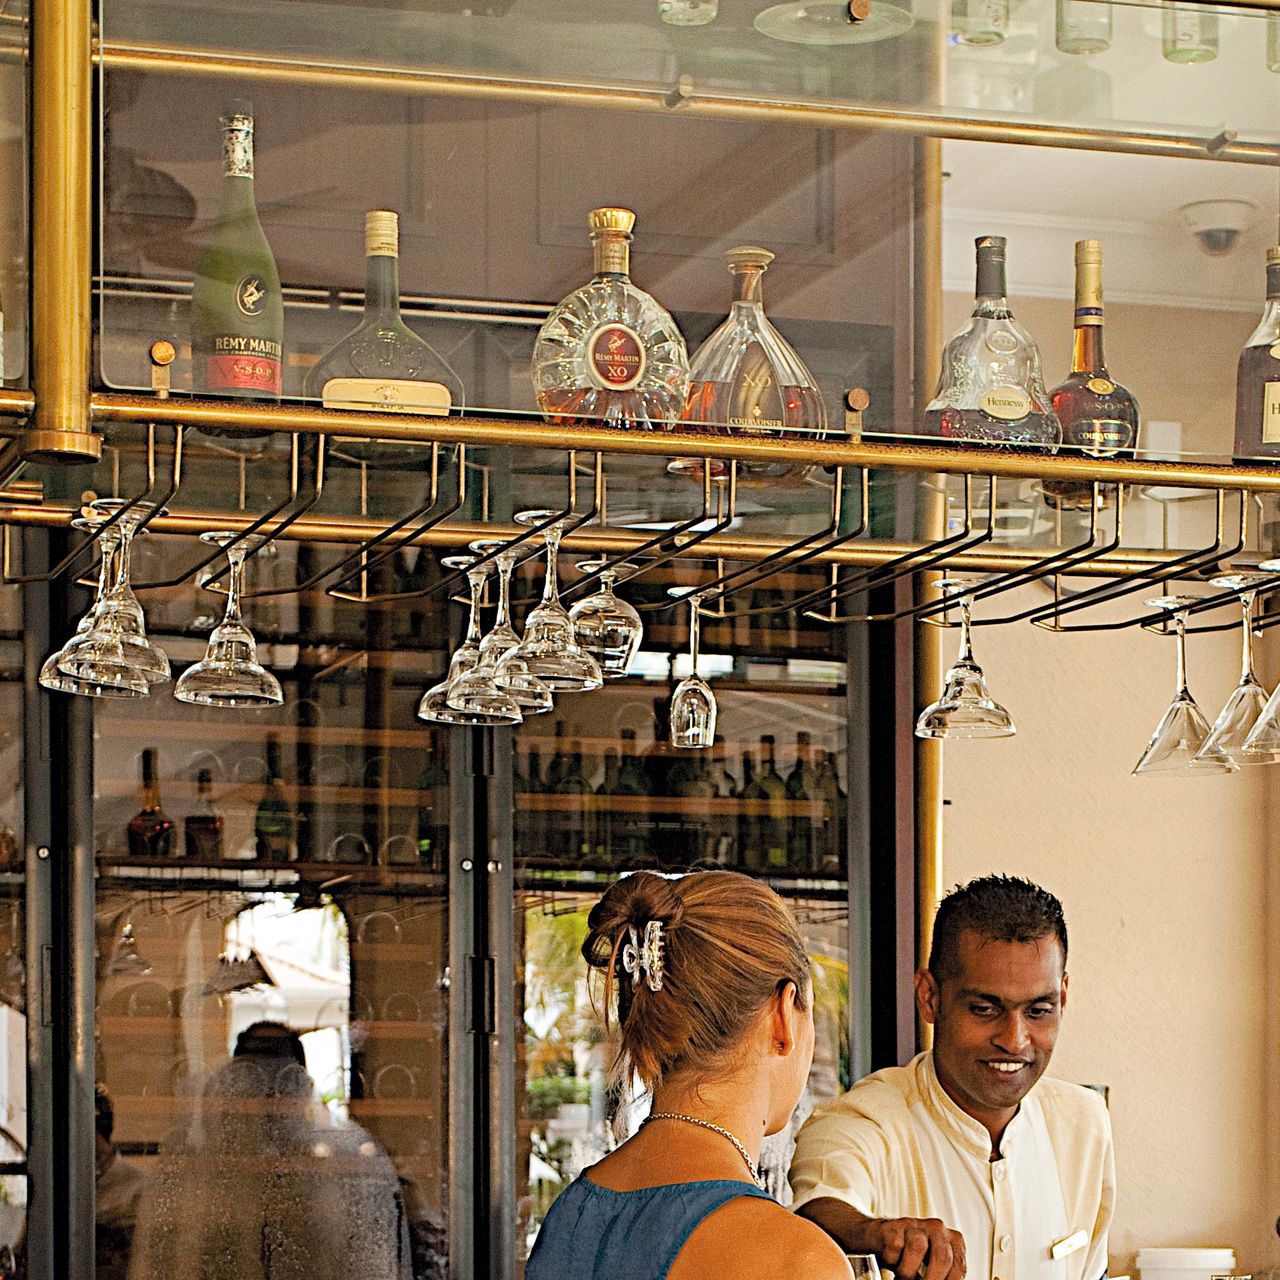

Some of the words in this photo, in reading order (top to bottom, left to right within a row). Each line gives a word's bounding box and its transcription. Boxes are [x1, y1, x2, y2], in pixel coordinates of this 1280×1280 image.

[215, 336, 248, 350] RÉMY
[249, 338, 282, 356] MARTIN
[614, 352, 639, 363] MARTIN
[607, 366, 628, 378] XO
[986, 396, 1025, 410] Hennessy
[729, 417, 784, 427] COURVOISIER
